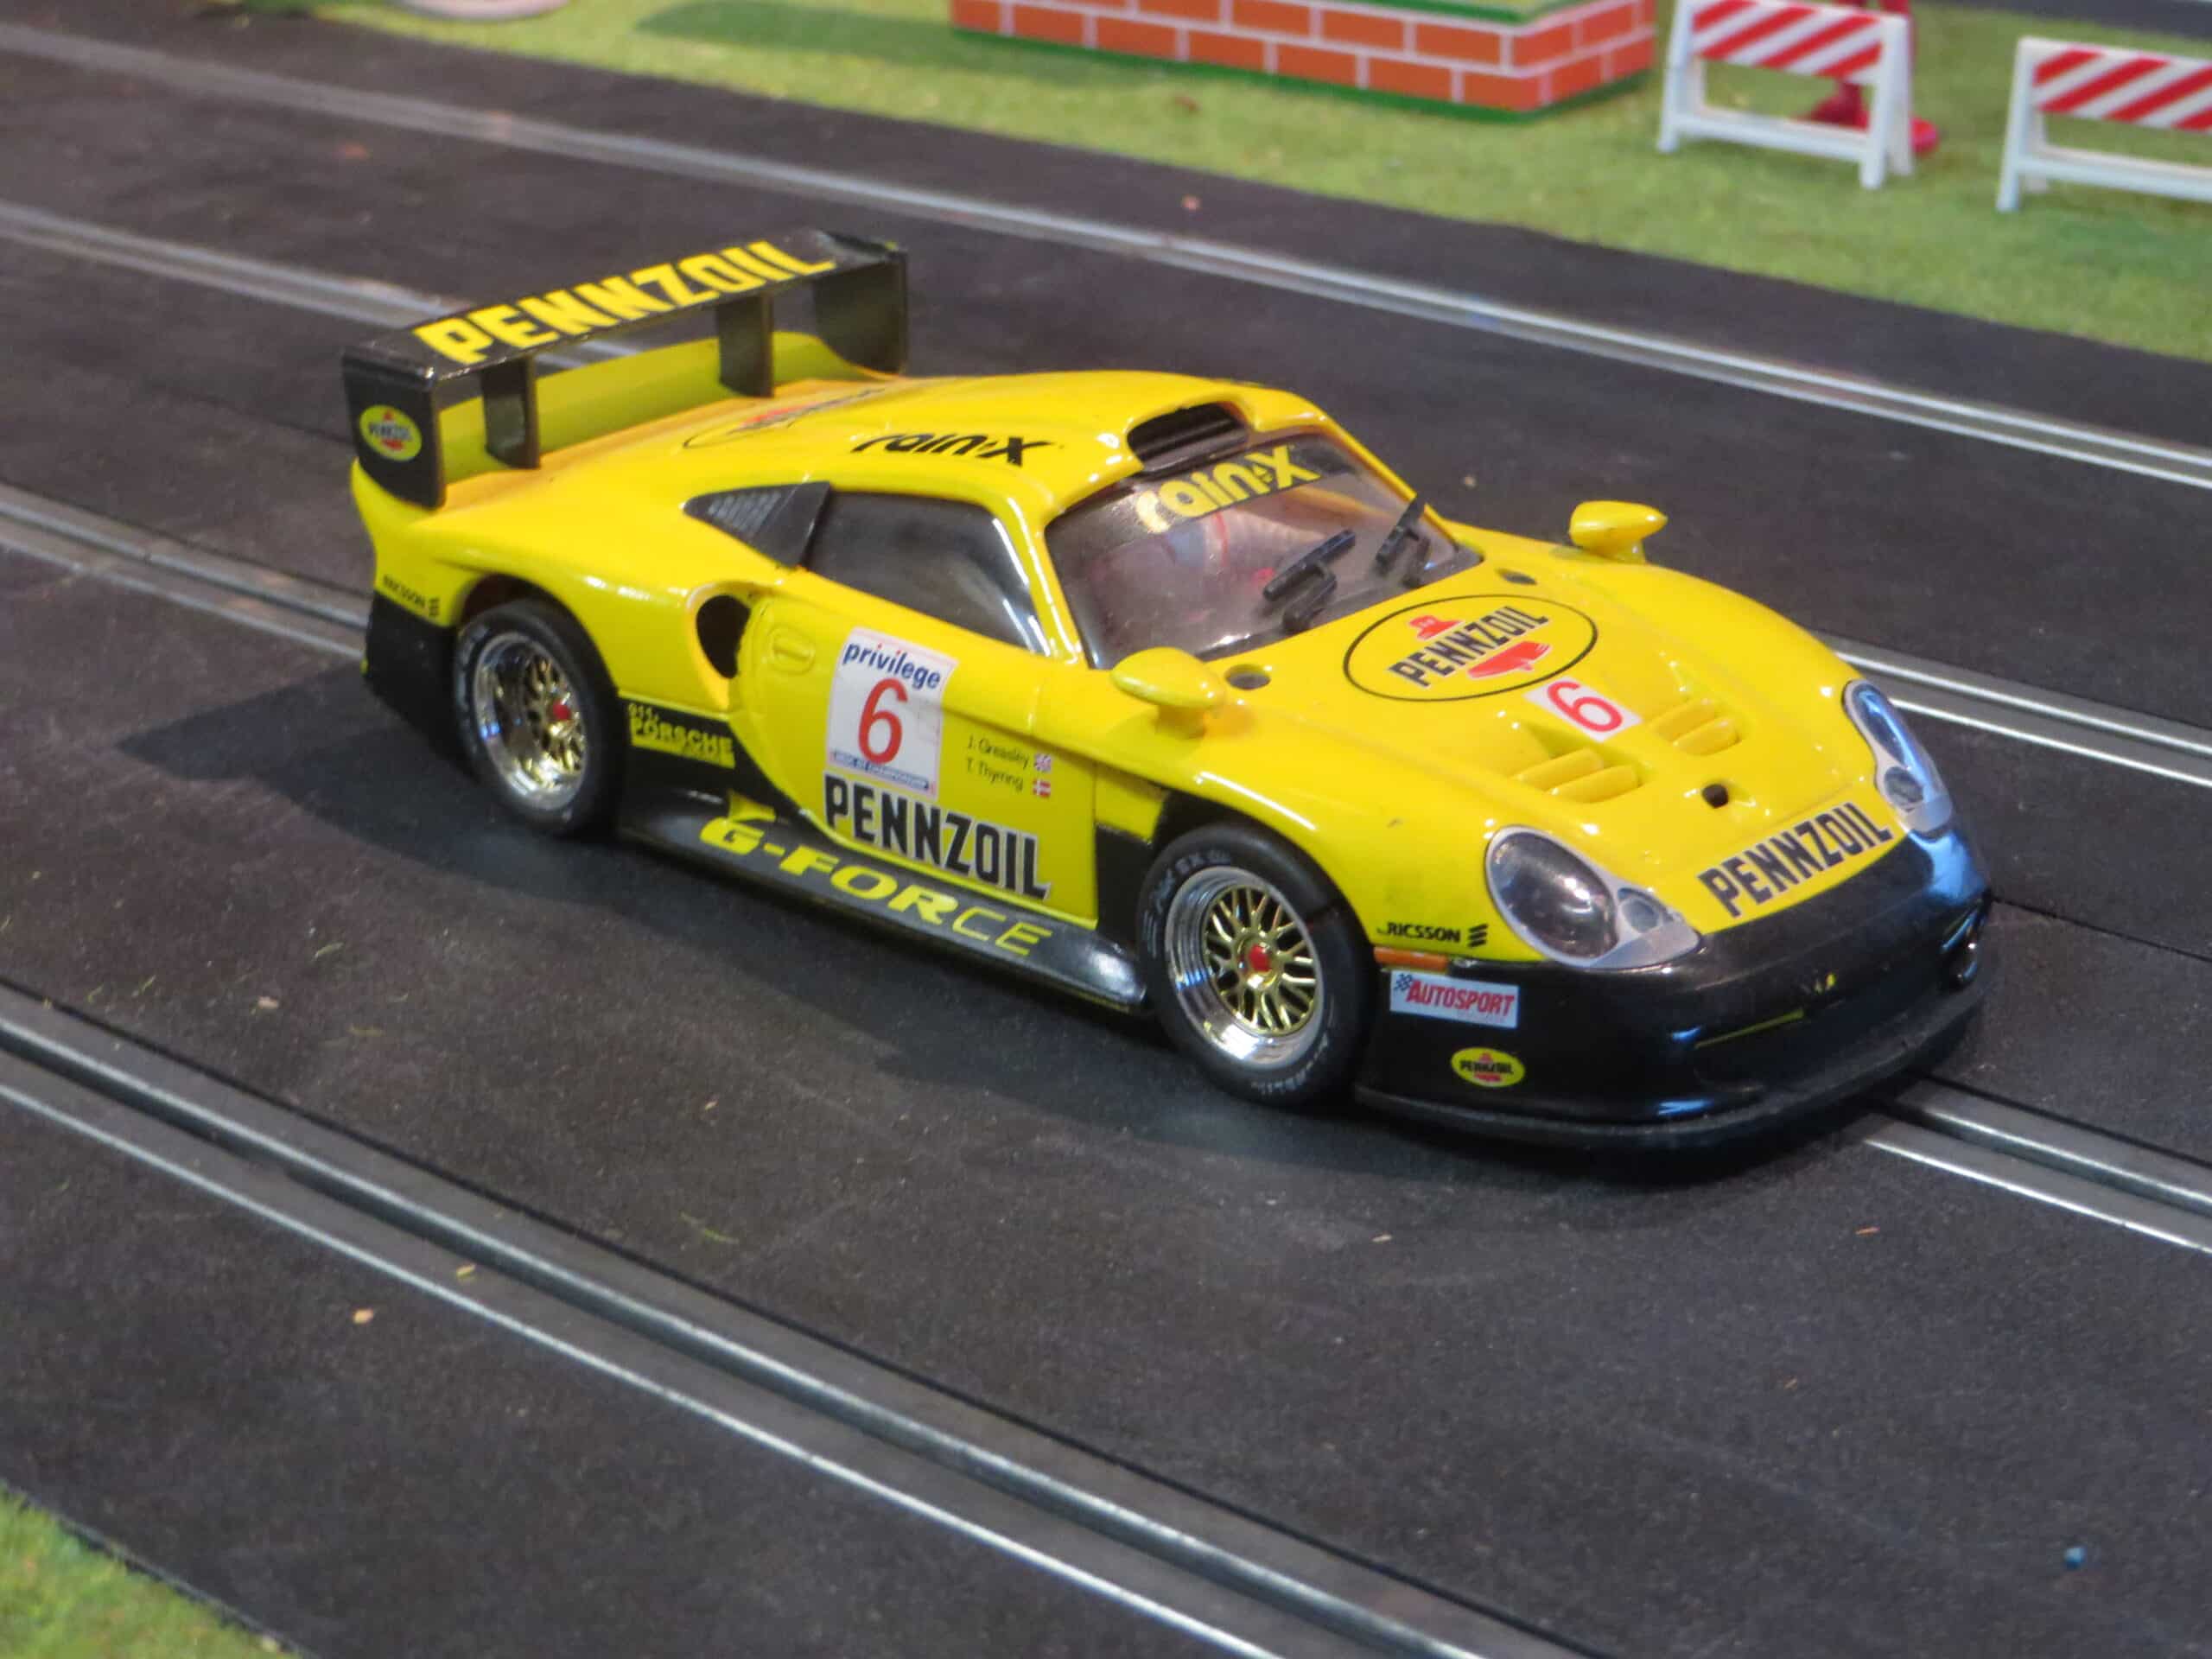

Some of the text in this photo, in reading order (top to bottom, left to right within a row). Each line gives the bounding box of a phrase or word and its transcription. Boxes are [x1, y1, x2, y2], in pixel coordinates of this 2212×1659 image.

[413, 240, 836, 365] PENNZOIL
[842, 642, 942, 690] privilege
[1388, 605, 1550, 688] PENNZOIL
[858, 677, 908, 766] 6
[1547, 681, 1624, 733] 6
[824, 772, 1051, 899] PENNZOIL
[1697, 802, 1893, 918] PENNZOIL
[699, 817, 1053, 956] G-FORCE
[1406, 981, 1515, 1017] AUTOSPORT
